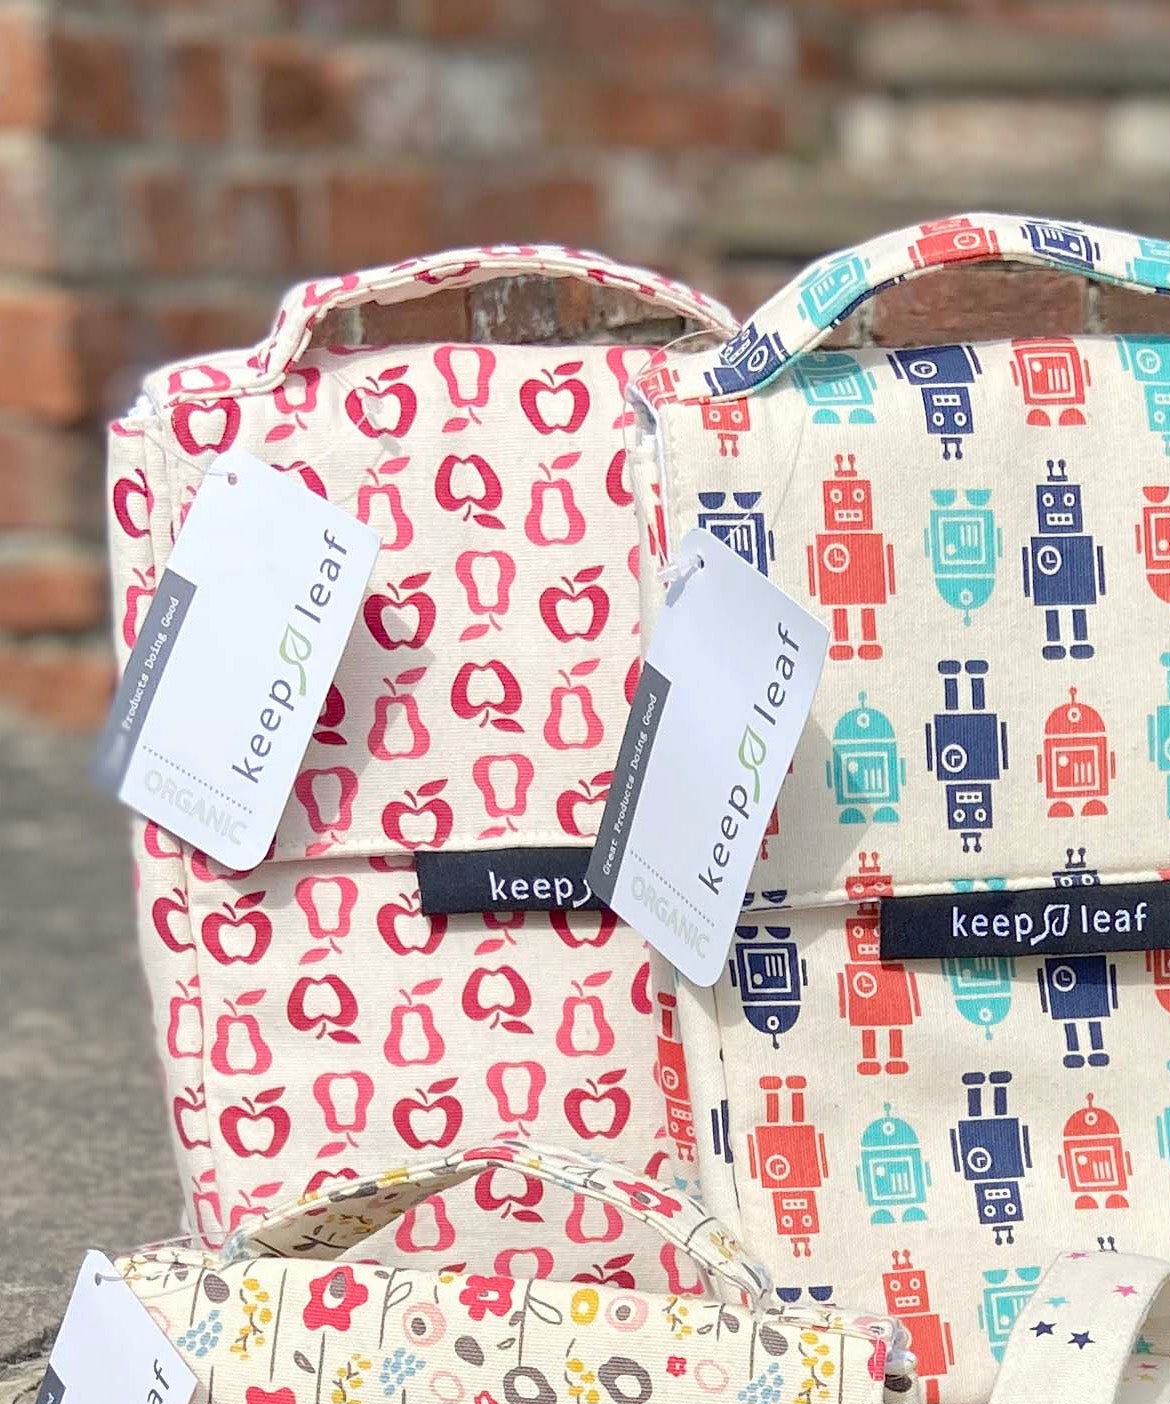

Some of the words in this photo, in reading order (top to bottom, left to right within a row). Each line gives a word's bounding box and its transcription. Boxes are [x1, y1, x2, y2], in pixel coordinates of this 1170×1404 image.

[122, 671, 150, 732] Products
[144, 631, 168, 670] Doing
[160, 596, 181, 628] Good
[231, 678, 295, 784] keep
[294, 528, 348, 624] leaf
[144, 768, 248, 846] ORGANIC
[602, 838, 619, 876] Great
[614, 776, 635, 834] Products
[630, 731, 649, 771] Doing
[641, 693, 658, 726] Good
[698, 783, 750, 896] keep
[753, 621, 800, 726] leaf
[488, 869, 574, 906] keep
[630, 875, 711, 960] ORGANIC
[952, 906, 1034, 943] keep
[1081, 902, 1148, 934] leaf
